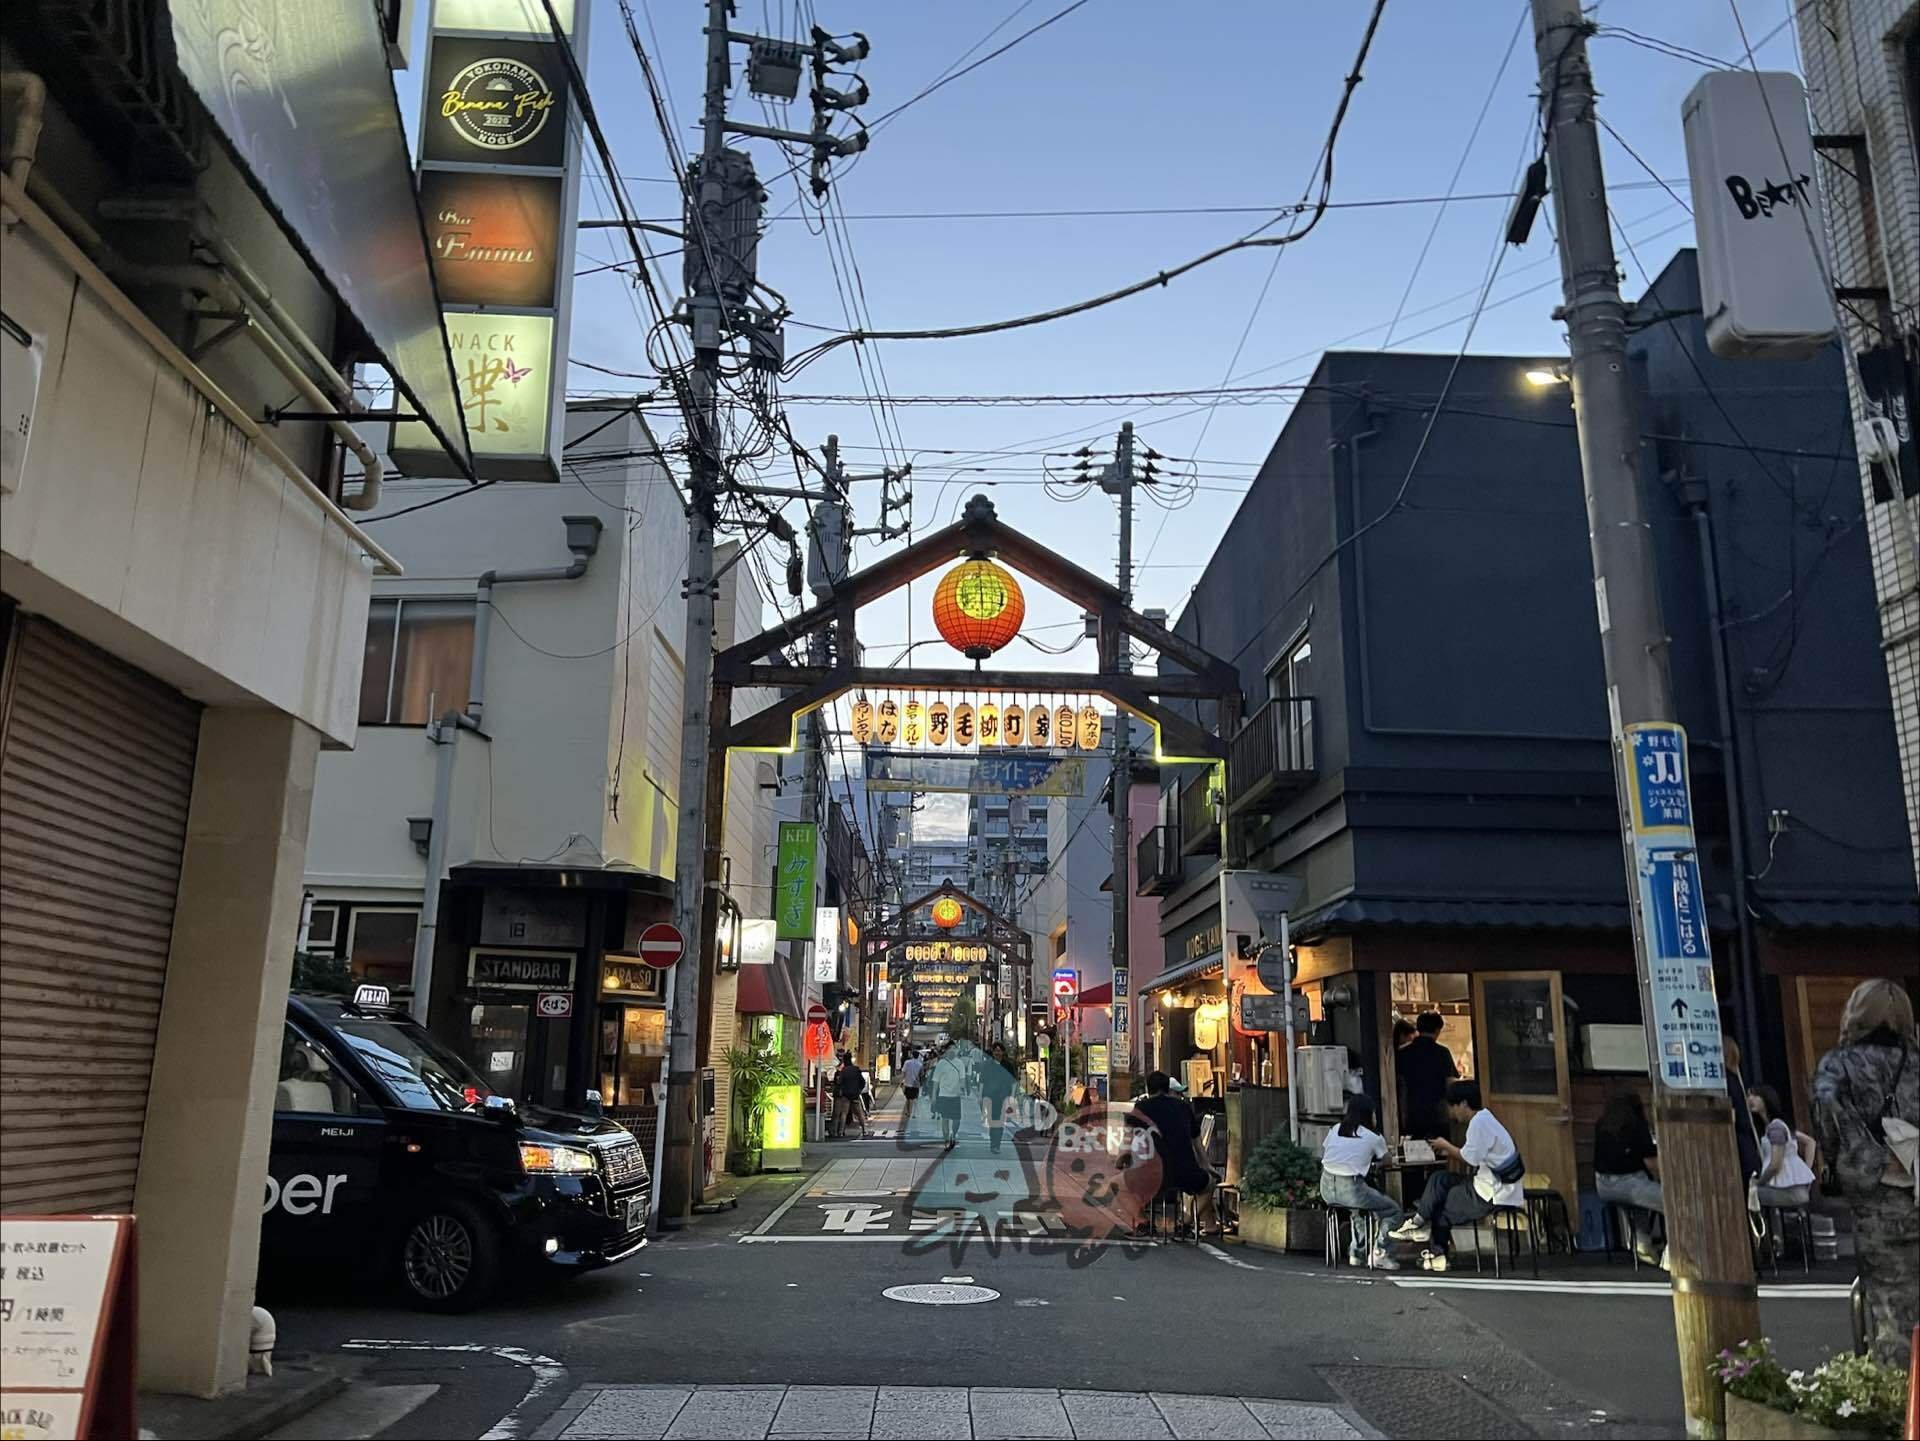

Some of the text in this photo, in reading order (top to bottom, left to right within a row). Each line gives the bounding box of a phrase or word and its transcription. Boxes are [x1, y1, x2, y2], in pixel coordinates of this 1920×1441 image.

[465, 62, 535, 84] YOKOHAMA
[486, 116, 510, 124] 2020
[478, 133, 515, 145] NOGE
[436, 231, 534, 262] Emma
[452, 332, 515, 351] NACK
[881, 703, 897, 737] はな
[1648, 751, 1682, 784] JJ
[480, 958, 562, 980] STANDBAR
[360, 989, 386, 1003] MEIJI
[320, 1127, 354, 1136] MEIJI
